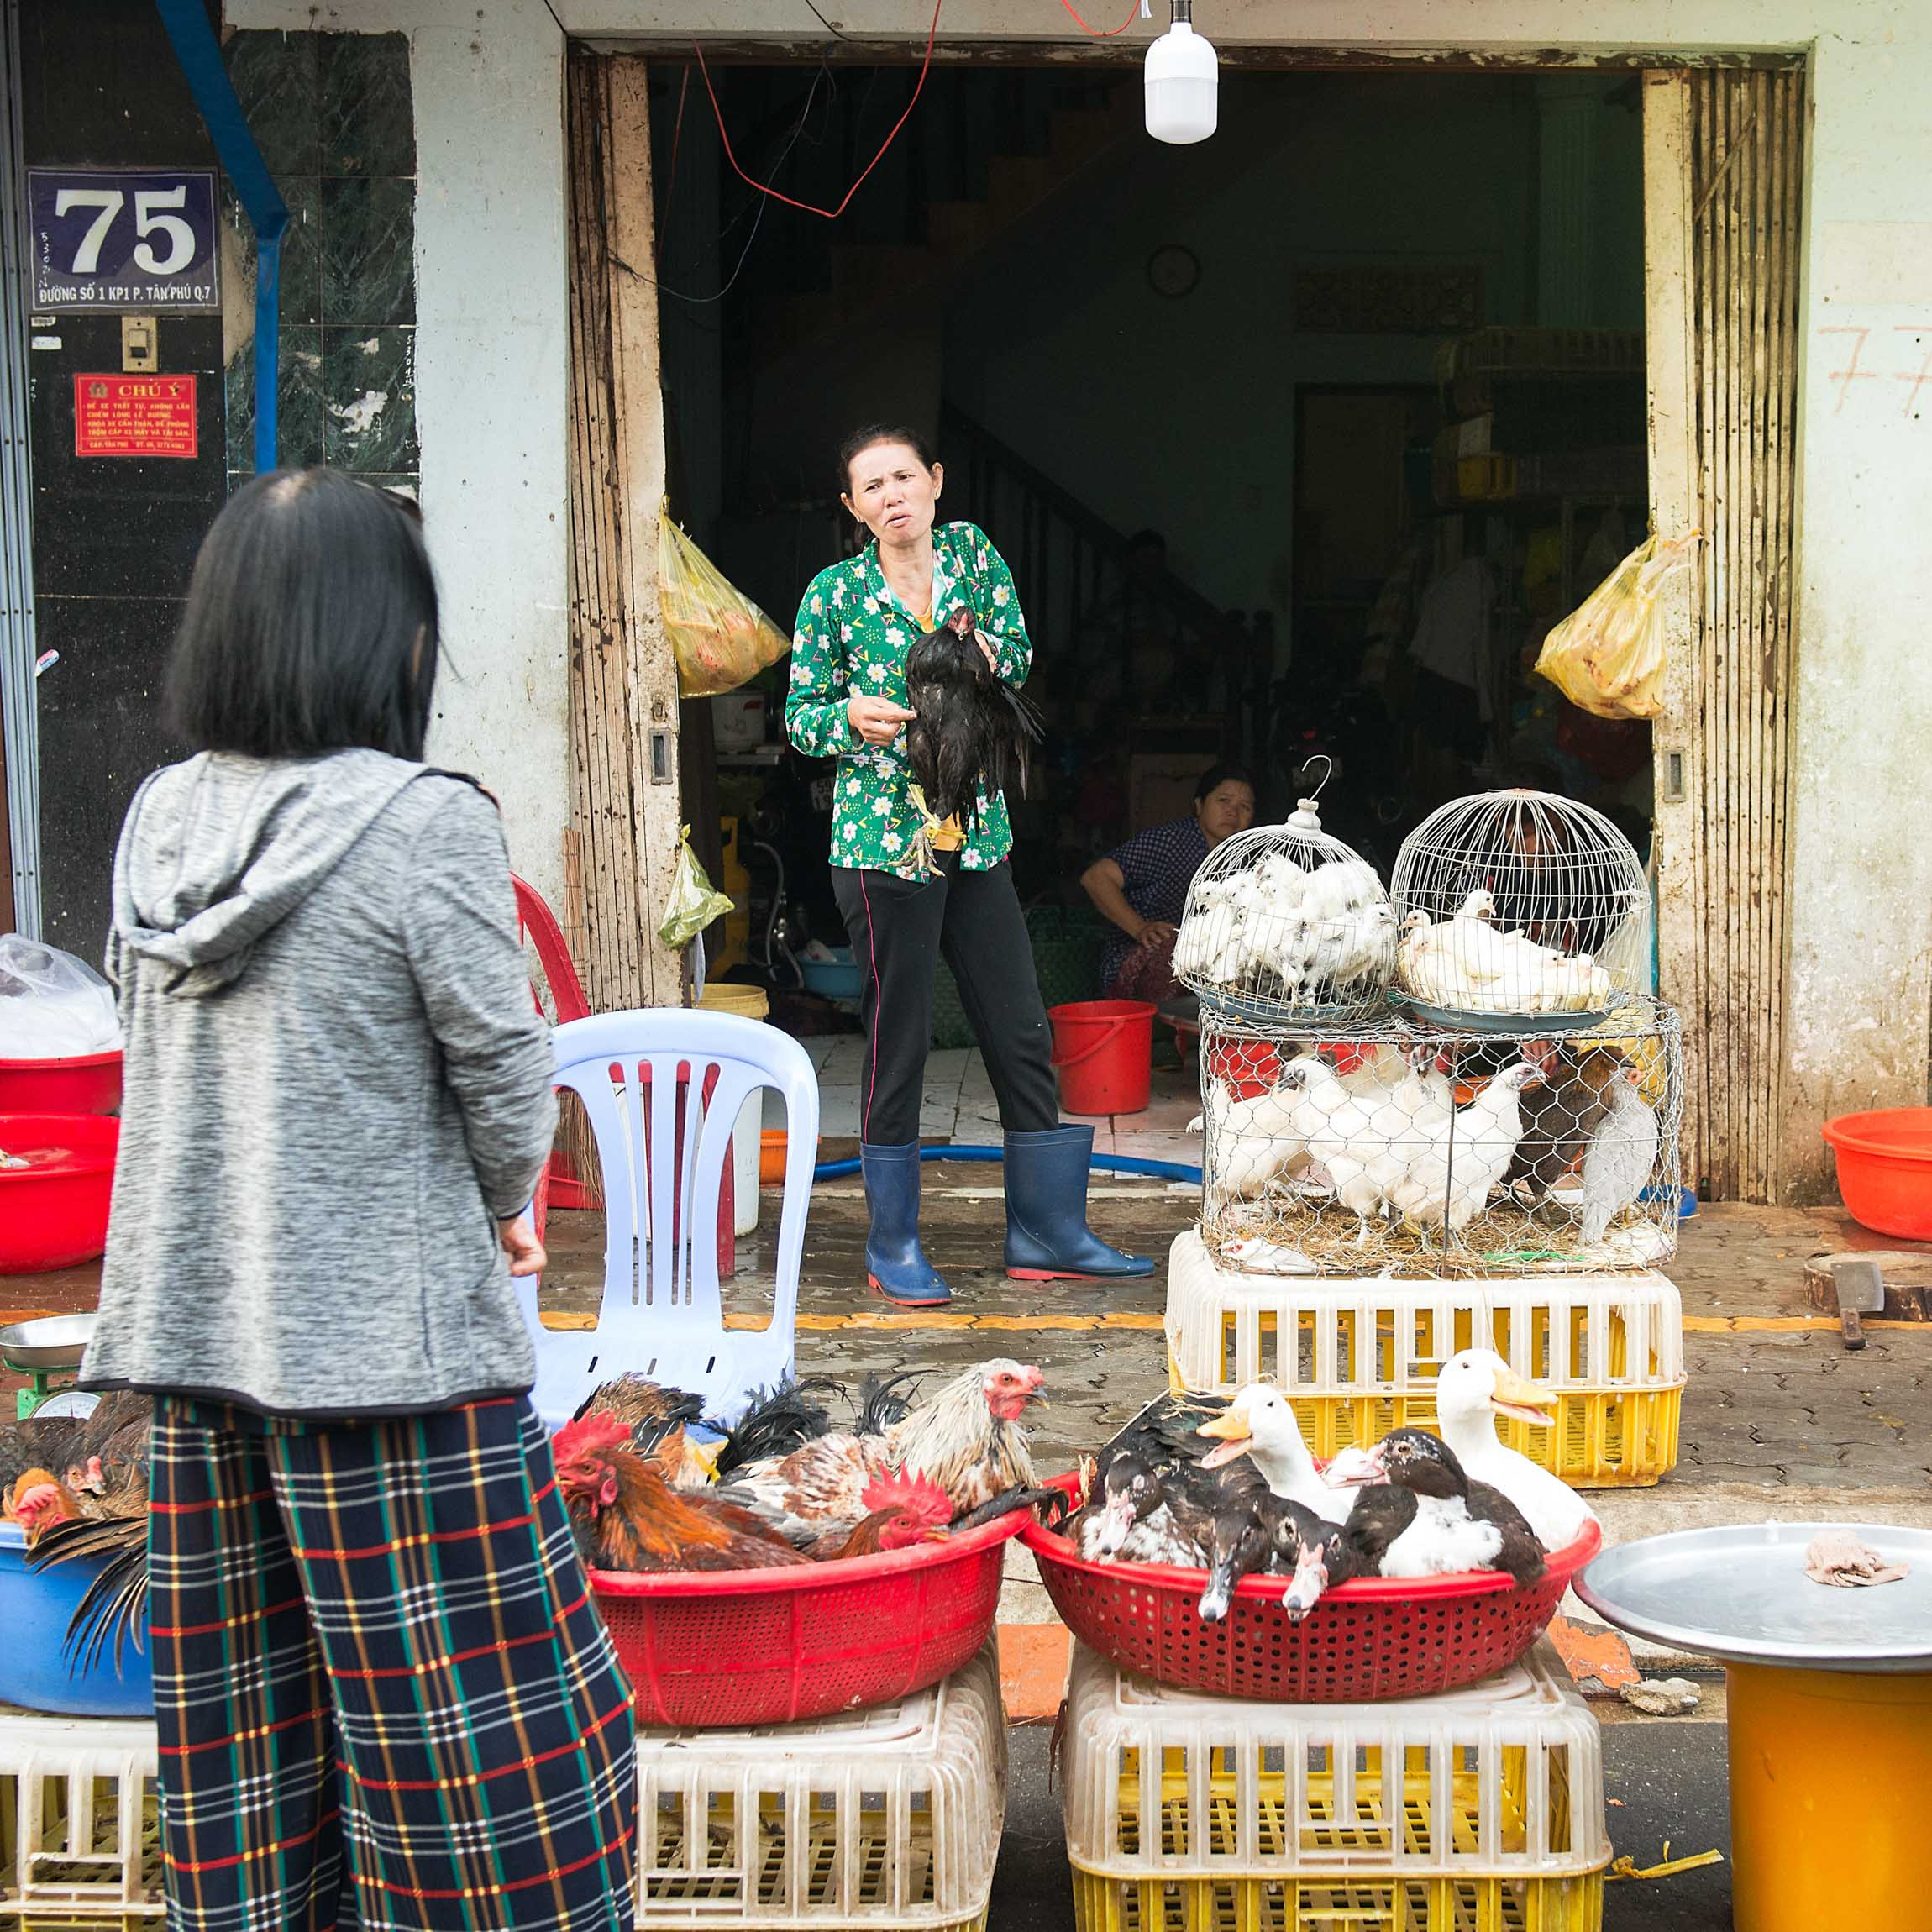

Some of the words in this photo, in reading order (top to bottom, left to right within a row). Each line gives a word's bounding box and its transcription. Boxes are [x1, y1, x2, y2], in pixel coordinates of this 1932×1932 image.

[55, 185, 196, 276] 75
[80, 281, 96, 301] SỐ
[99, 286, 106, 301] 1
[108, 286, 129, 301] KP1
[133, 286, 144, 301] P.
[145, 283, 168, 301] TÂN
[171, 282, 192, 300] PHÚ
[194, 286, 211, 302] Q.7
[118, 381, 162, 397] CHÚ
